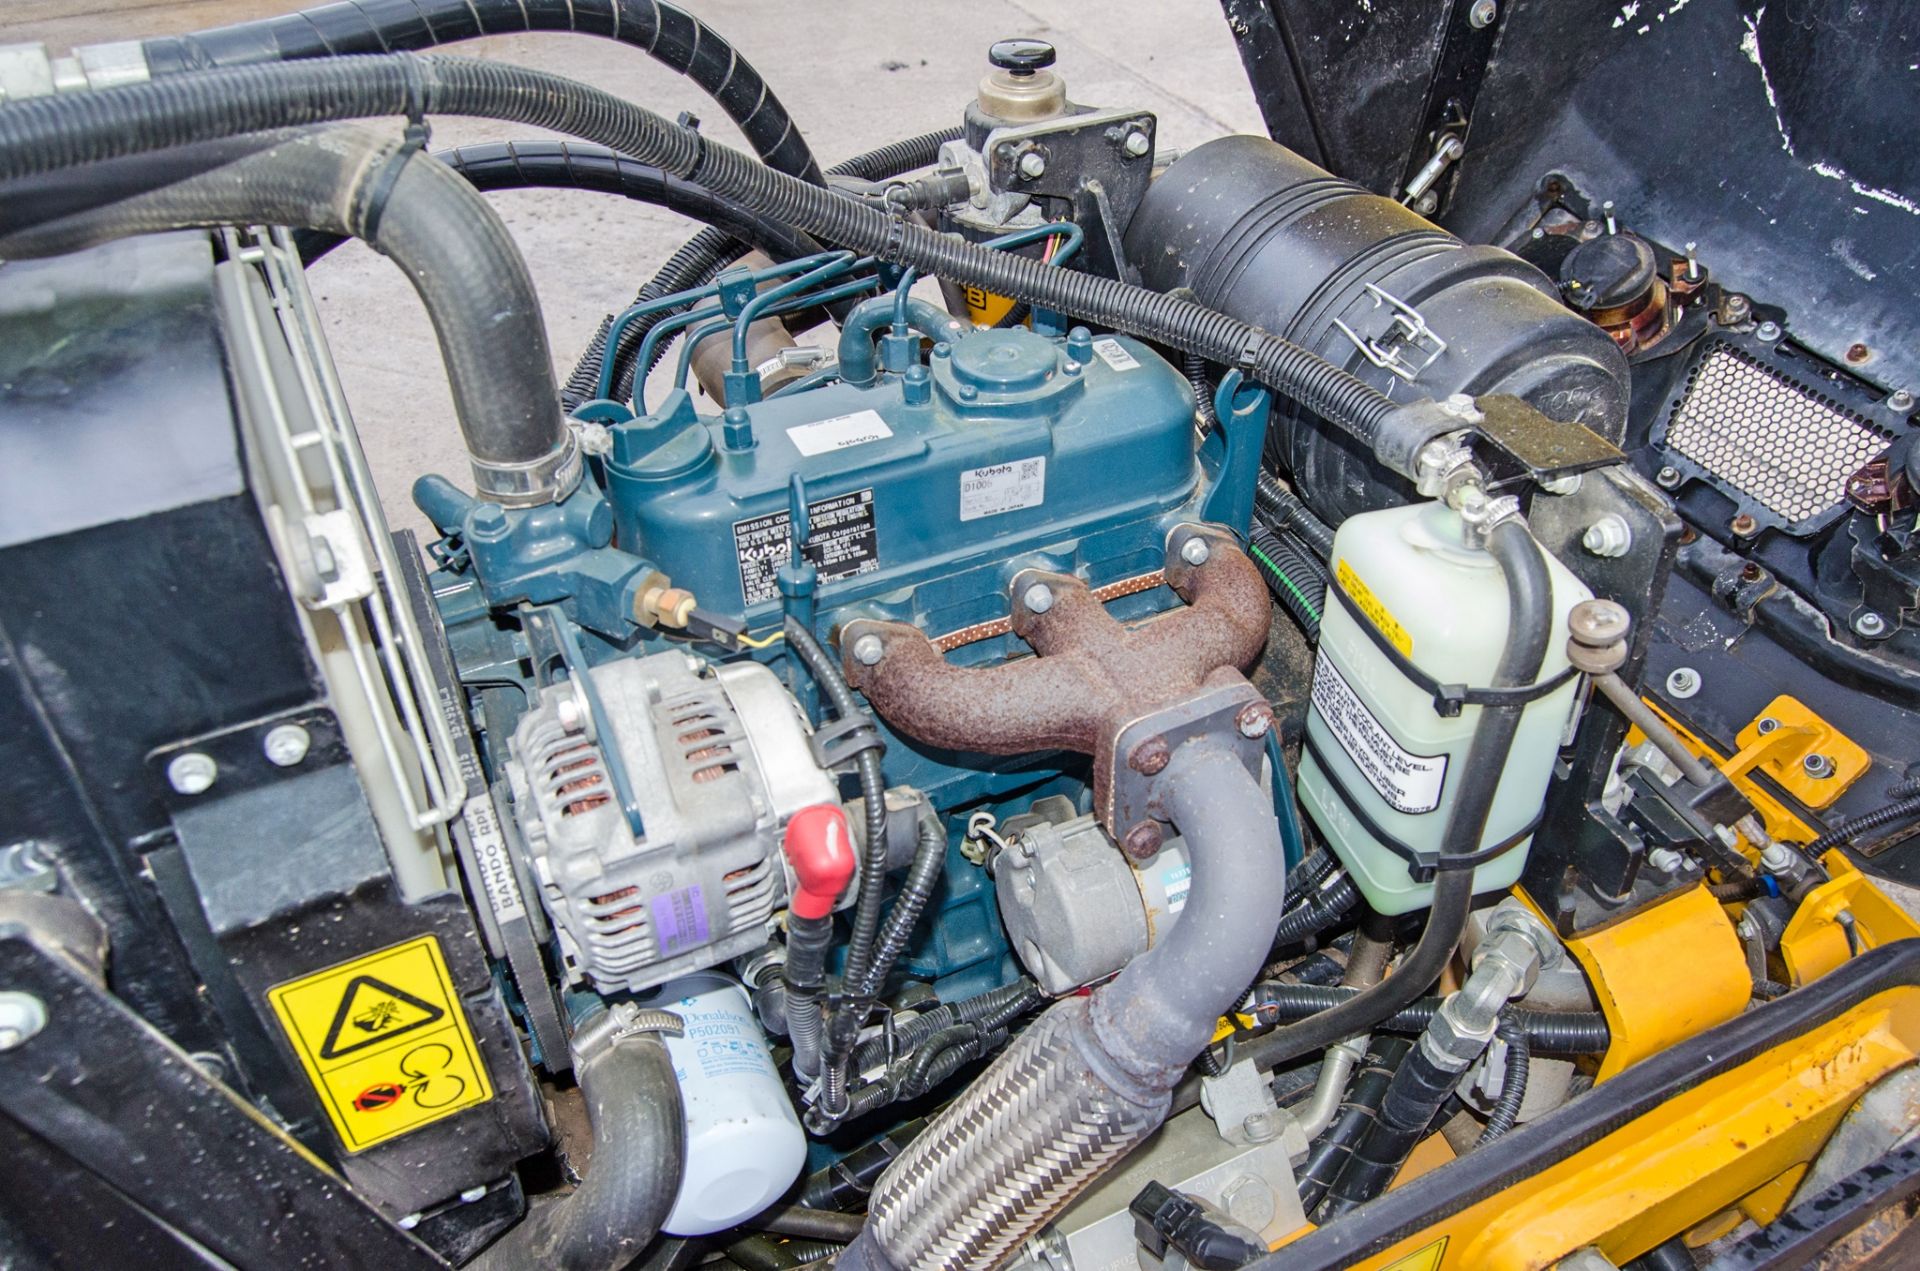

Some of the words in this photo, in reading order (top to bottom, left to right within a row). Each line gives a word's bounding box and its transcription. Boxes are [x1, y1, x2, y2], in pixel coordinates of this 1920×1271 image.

[975, 465, 1012, 478] Kubota
[736, 518, 773, 534] EMISSION
[810, 497, 855, 514] INFORMATION
[832, 523, 871, 538] Corporation
[1357, 707, 1393, 753] COOLANT
[1395, 760, 1411, 776] BE
[1380, 770, 1406, 797] USER
[474, 808, 491, 836] RPF
[486, 844, 514, 908] BANDO
